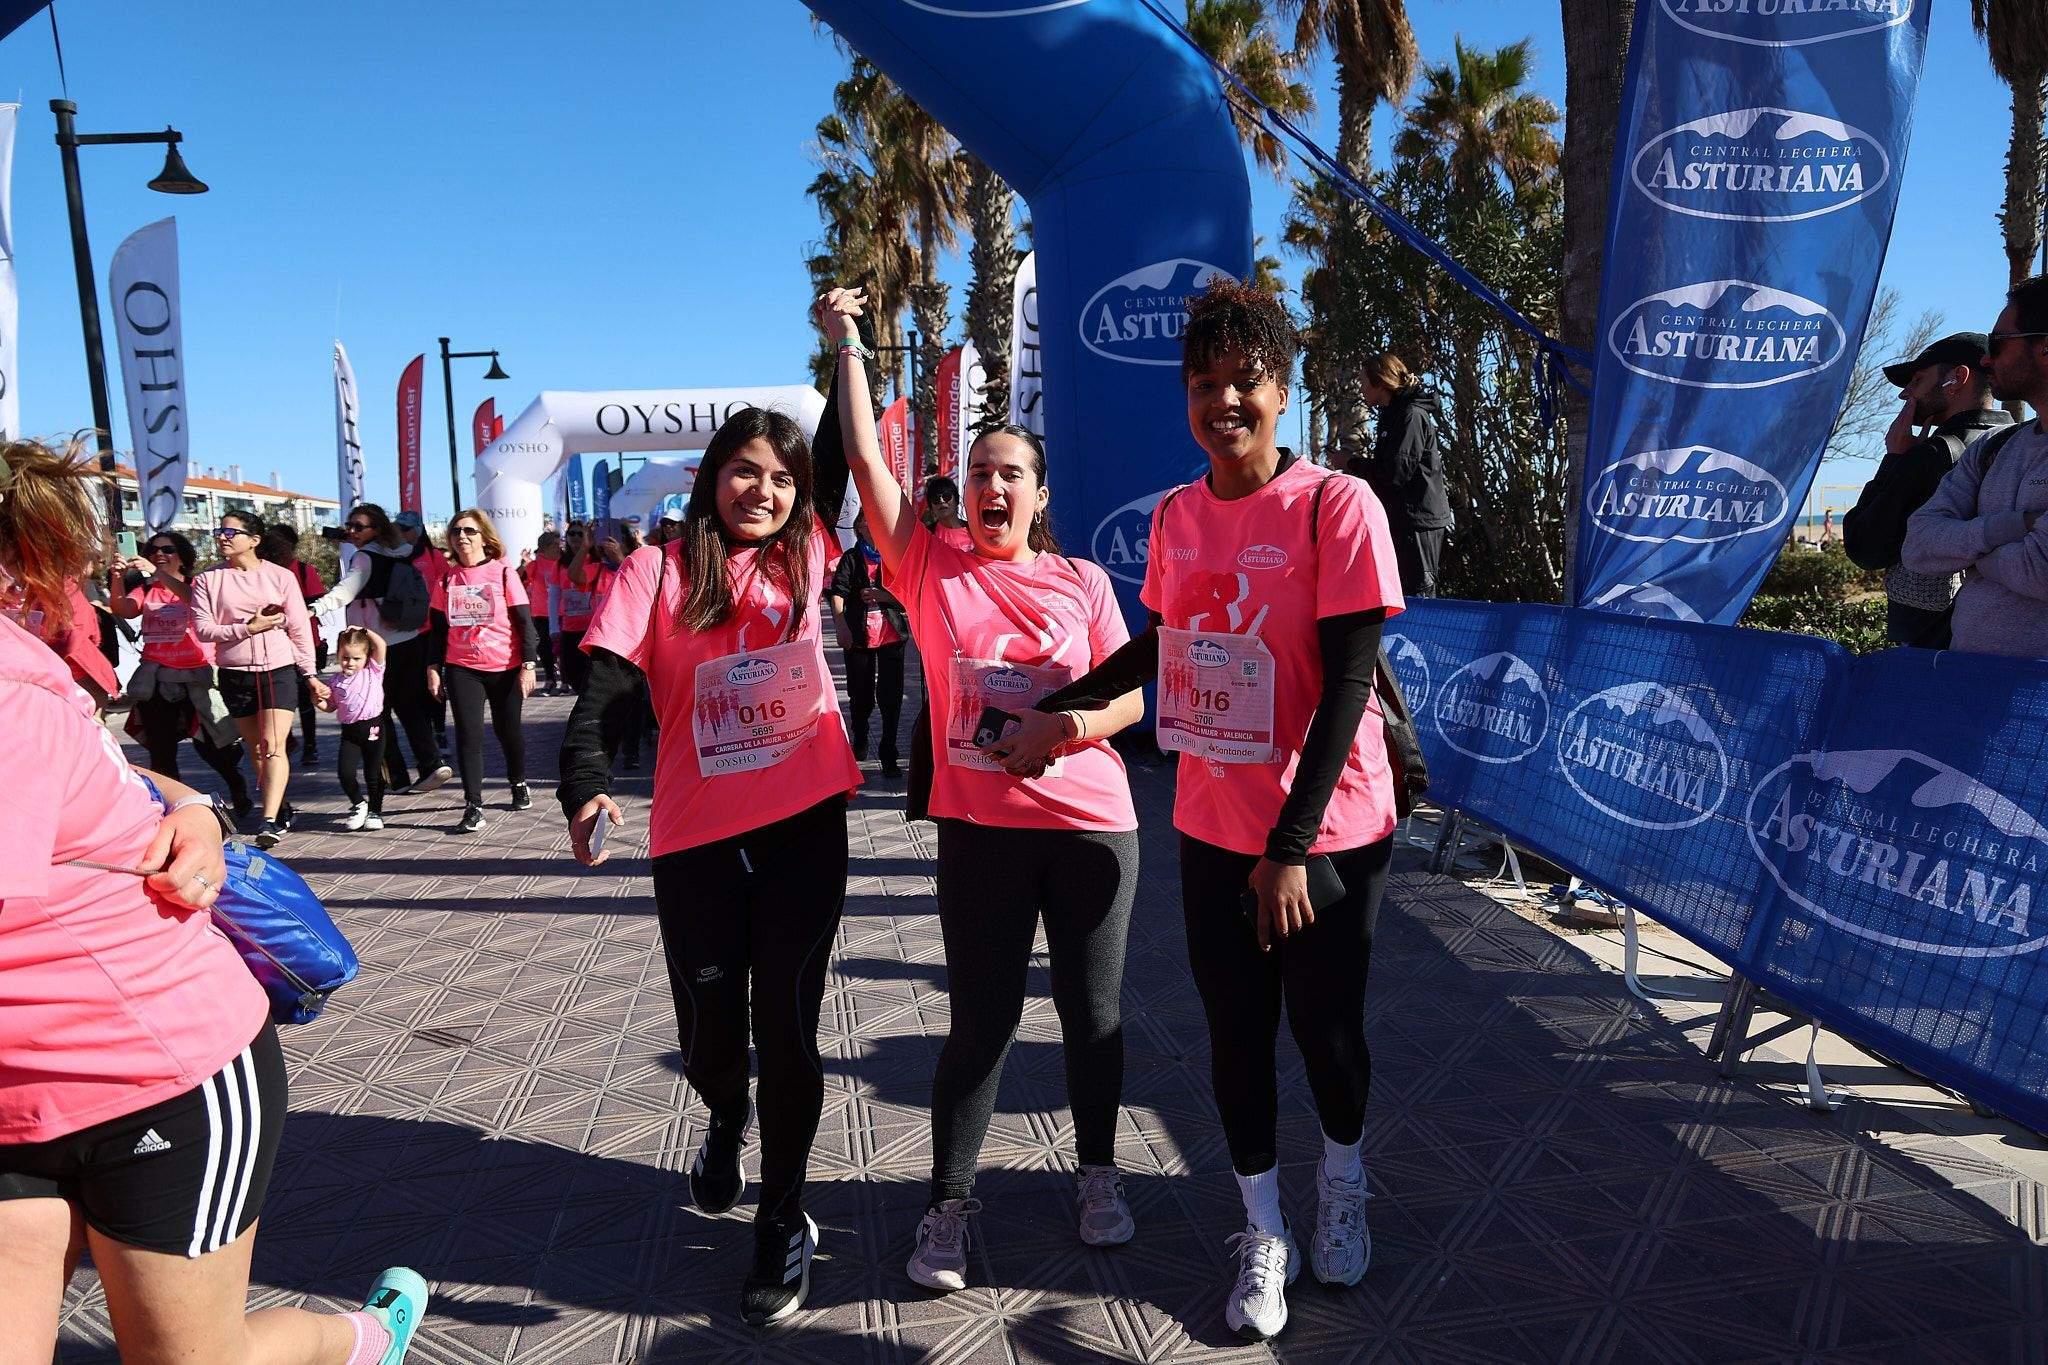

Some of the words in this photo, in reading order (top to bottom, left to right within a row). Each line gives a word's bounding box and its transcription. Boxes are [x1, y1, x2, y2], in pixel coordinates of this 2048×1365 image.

[1690, 145, 1770, 158] CENTRAL
[1779, 145, 1863, 158] LECHERA
[1648, 147, 1864, 193] ASTURIANA
[1124, 296, 1185, 309] CENTRA
[1661, 314, 1737, 329] CENTRAL
[1746, 320, 1822, 331] LECHERA
[1623, 315, 1821, 363] ASTURIANA
[124, 281, 180, 533] OYSHO
[947, 372, 960, 462] Santander
[498, 442, 549, 454] OYSHO
[1629, 478, 1690, 490] CENTRAL
[1695, 480, 1769, 496] LECHERA
[1596, 479, 1766, 524] ASTURIANA
[731, 667, 775, 681] ASTURIANA
[987, 676, 1030, 690] ASTURIANA
[1190, 688, 1230, 711] 016
[739, 699, 786, 724] 016
[1194, 714, 1213, 725] 5700
[752, 726, 774, 737] 5699
[1223, 731, 1254, 741] VALENCIA
[715, 743, 743, 754] CARRERA
[762, 736, 783, 746] MUJER
[1216, 745, 1256, 757] Santander
[716, 754, 757, 768] OYSHO
[1565, 715, 1706, 812] ASTURIANA
[1911, 821, 2038, 872] LECHERA
[1757, 783, 2031, 937] ASTURIANA
[134, 1140, 171, 1154] adidas
